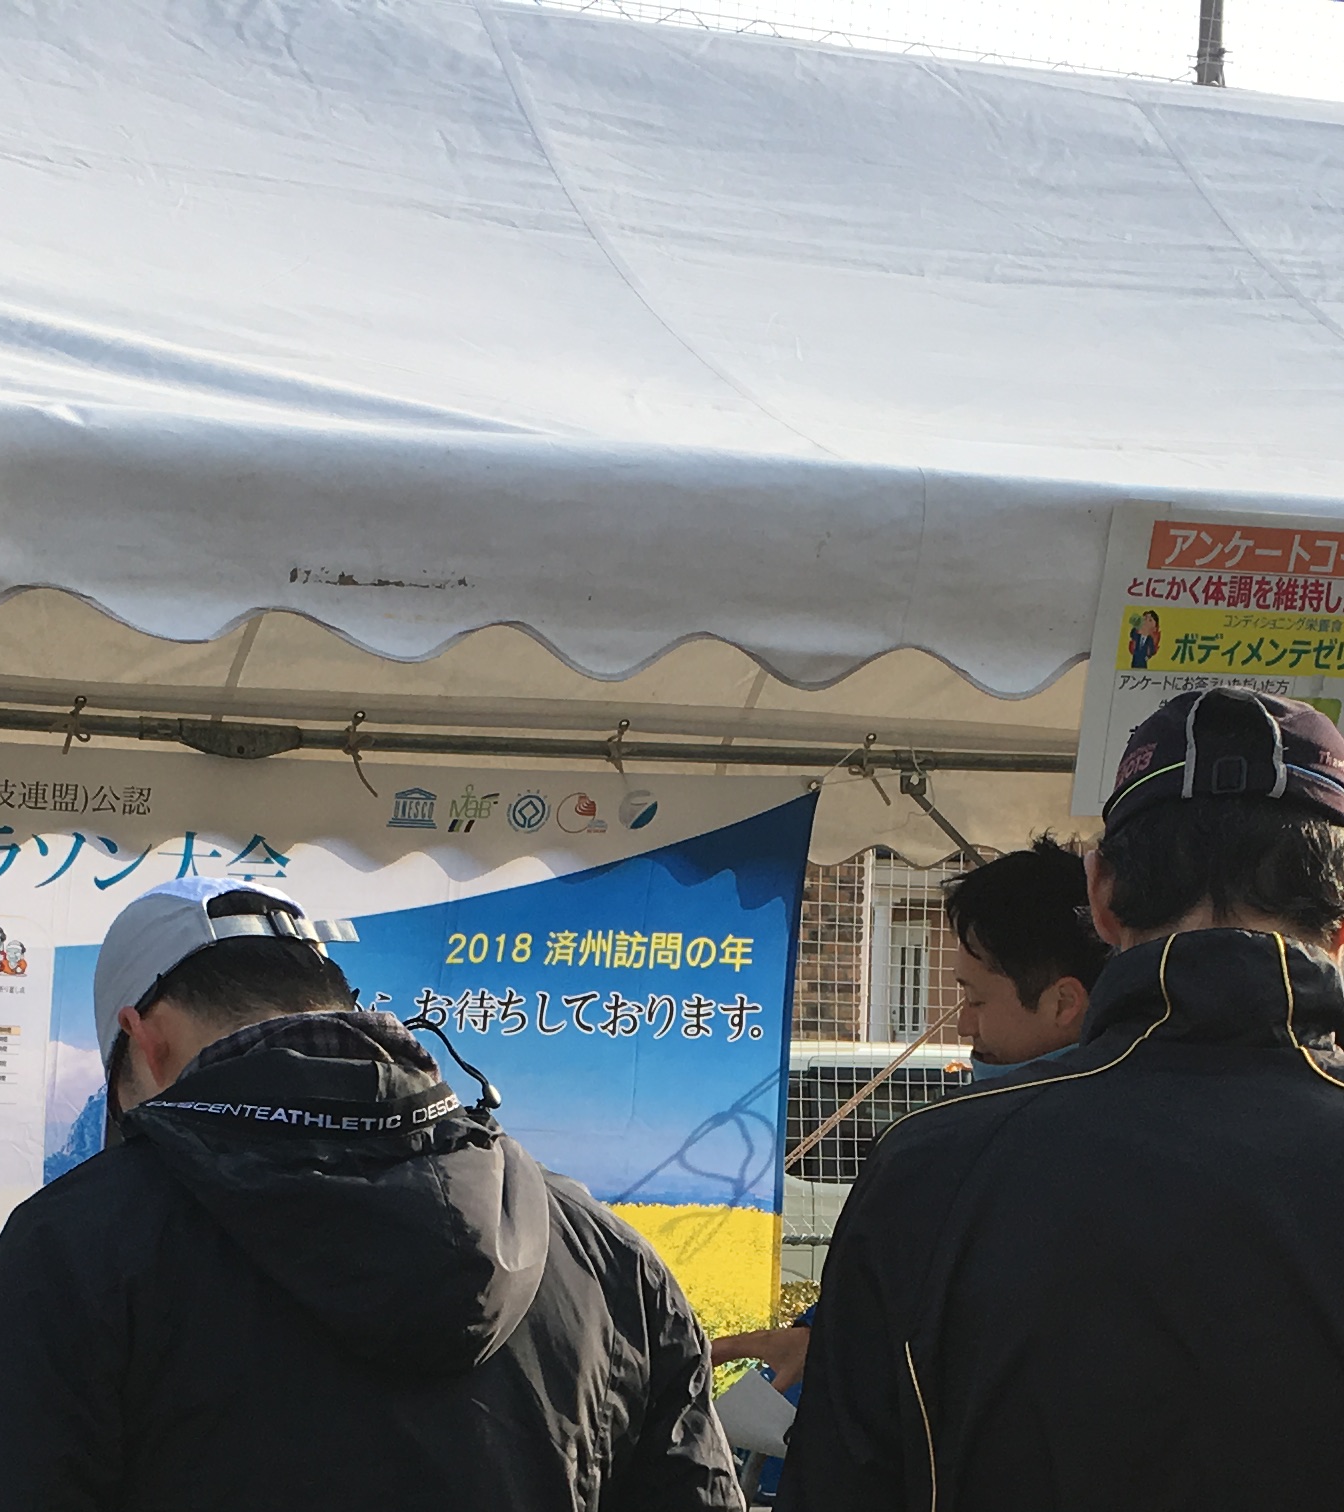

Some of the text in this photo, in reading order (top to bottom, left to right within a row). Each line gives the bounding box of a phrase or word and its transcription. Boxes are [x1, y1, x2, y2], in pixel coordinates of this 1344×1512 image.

[394, 799, 435, 820] UNESCO
[446, 929, 755, 973] 2018 済州訪問の年
[414, 986, 764, 1043] お待ちしております。
